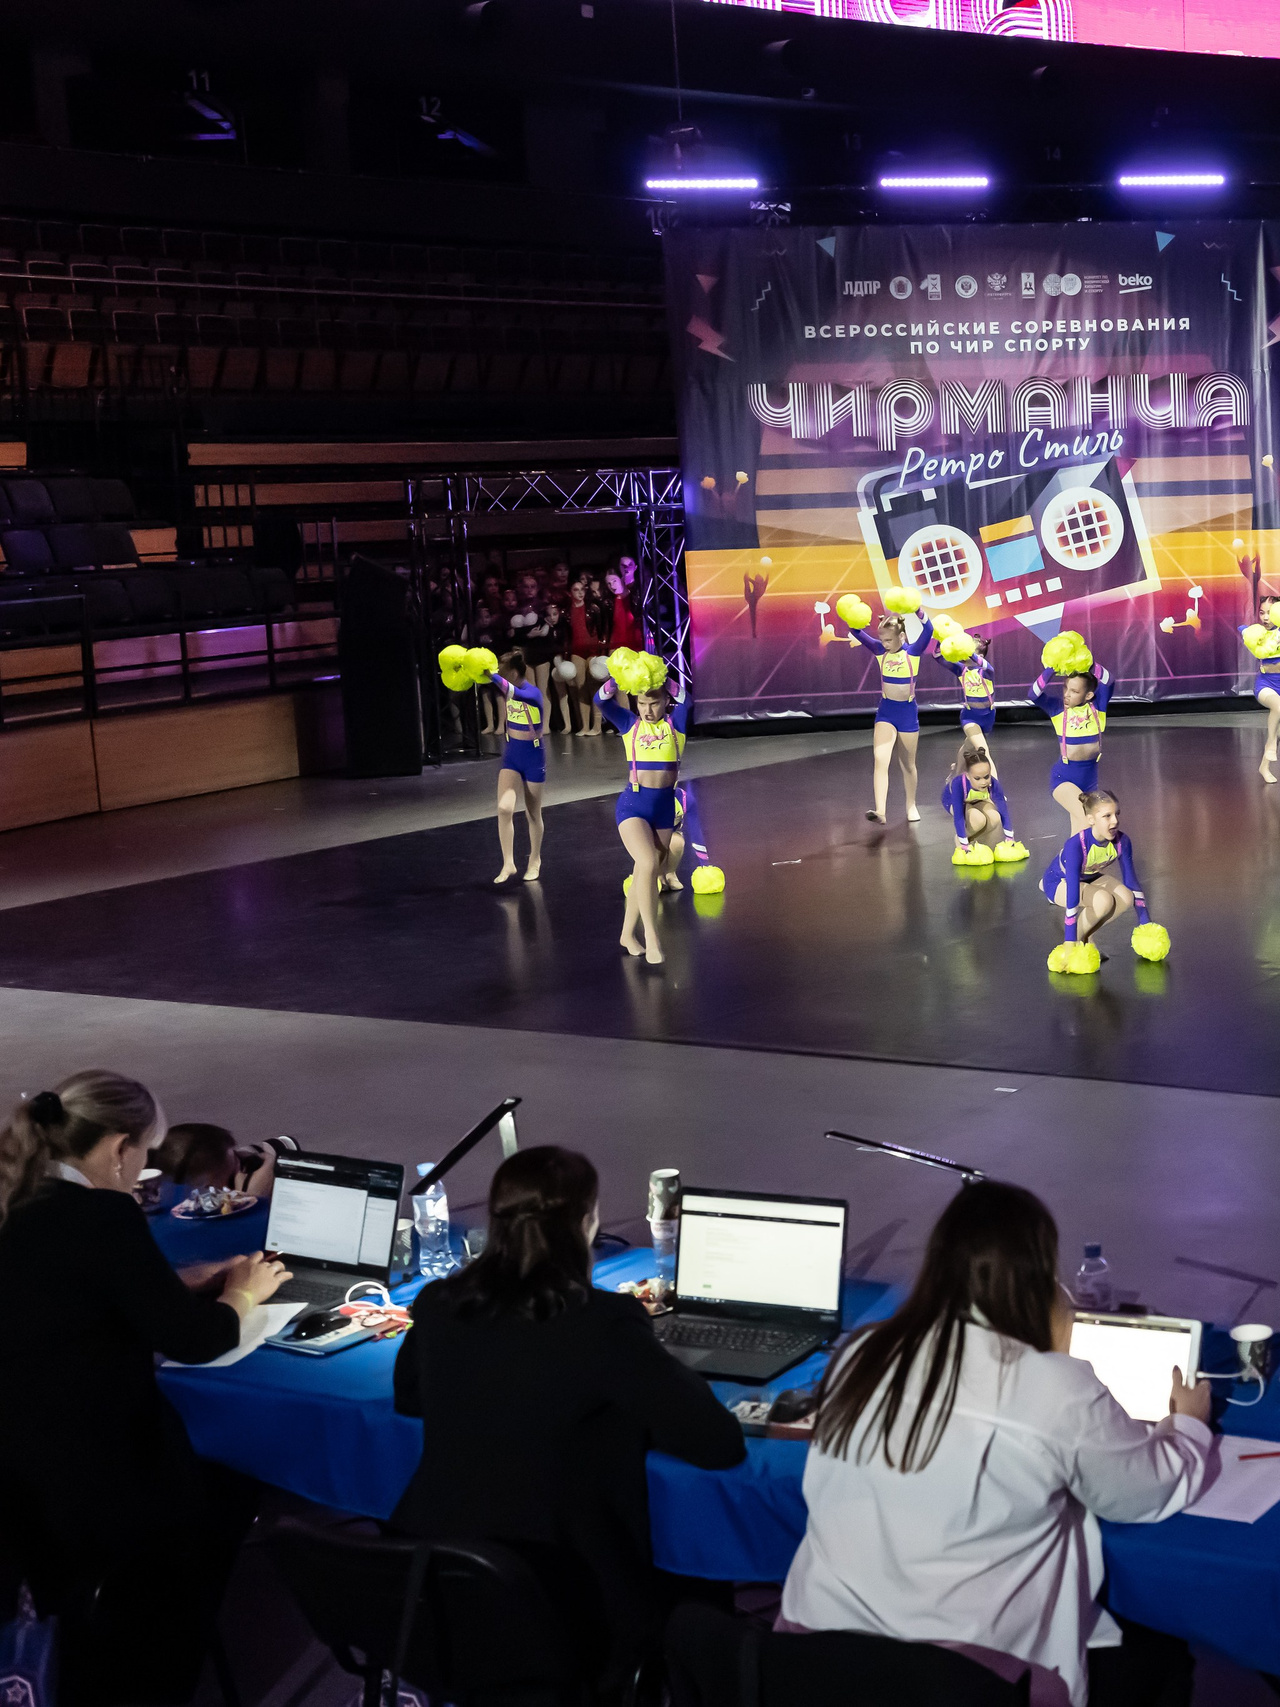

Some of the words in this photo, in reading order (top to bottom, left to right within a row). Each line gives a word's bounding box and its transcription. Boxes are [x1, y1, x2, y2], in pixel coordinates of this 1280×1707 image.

[187, 69, 211, 92] 11
[418, 96, 442, 117] 12
[843, 280, 881, 297] ЛДПР
[1118, 273, 1153, 286] beko
[804, 320, 1001, 339] ВСЕРОССИЙСКИЕ
[1010, 317, 1191, 335] СОРЕВНОВАНИЯ
[909, 340, 941, 355] ПО
[950, 339, 995, 354] ЧИР
[1004, 337, 1092, 353] СПОРТУ
[899, 446, 1004, 489] Ретро
[1019, 428, 1124, 467] Стиль
